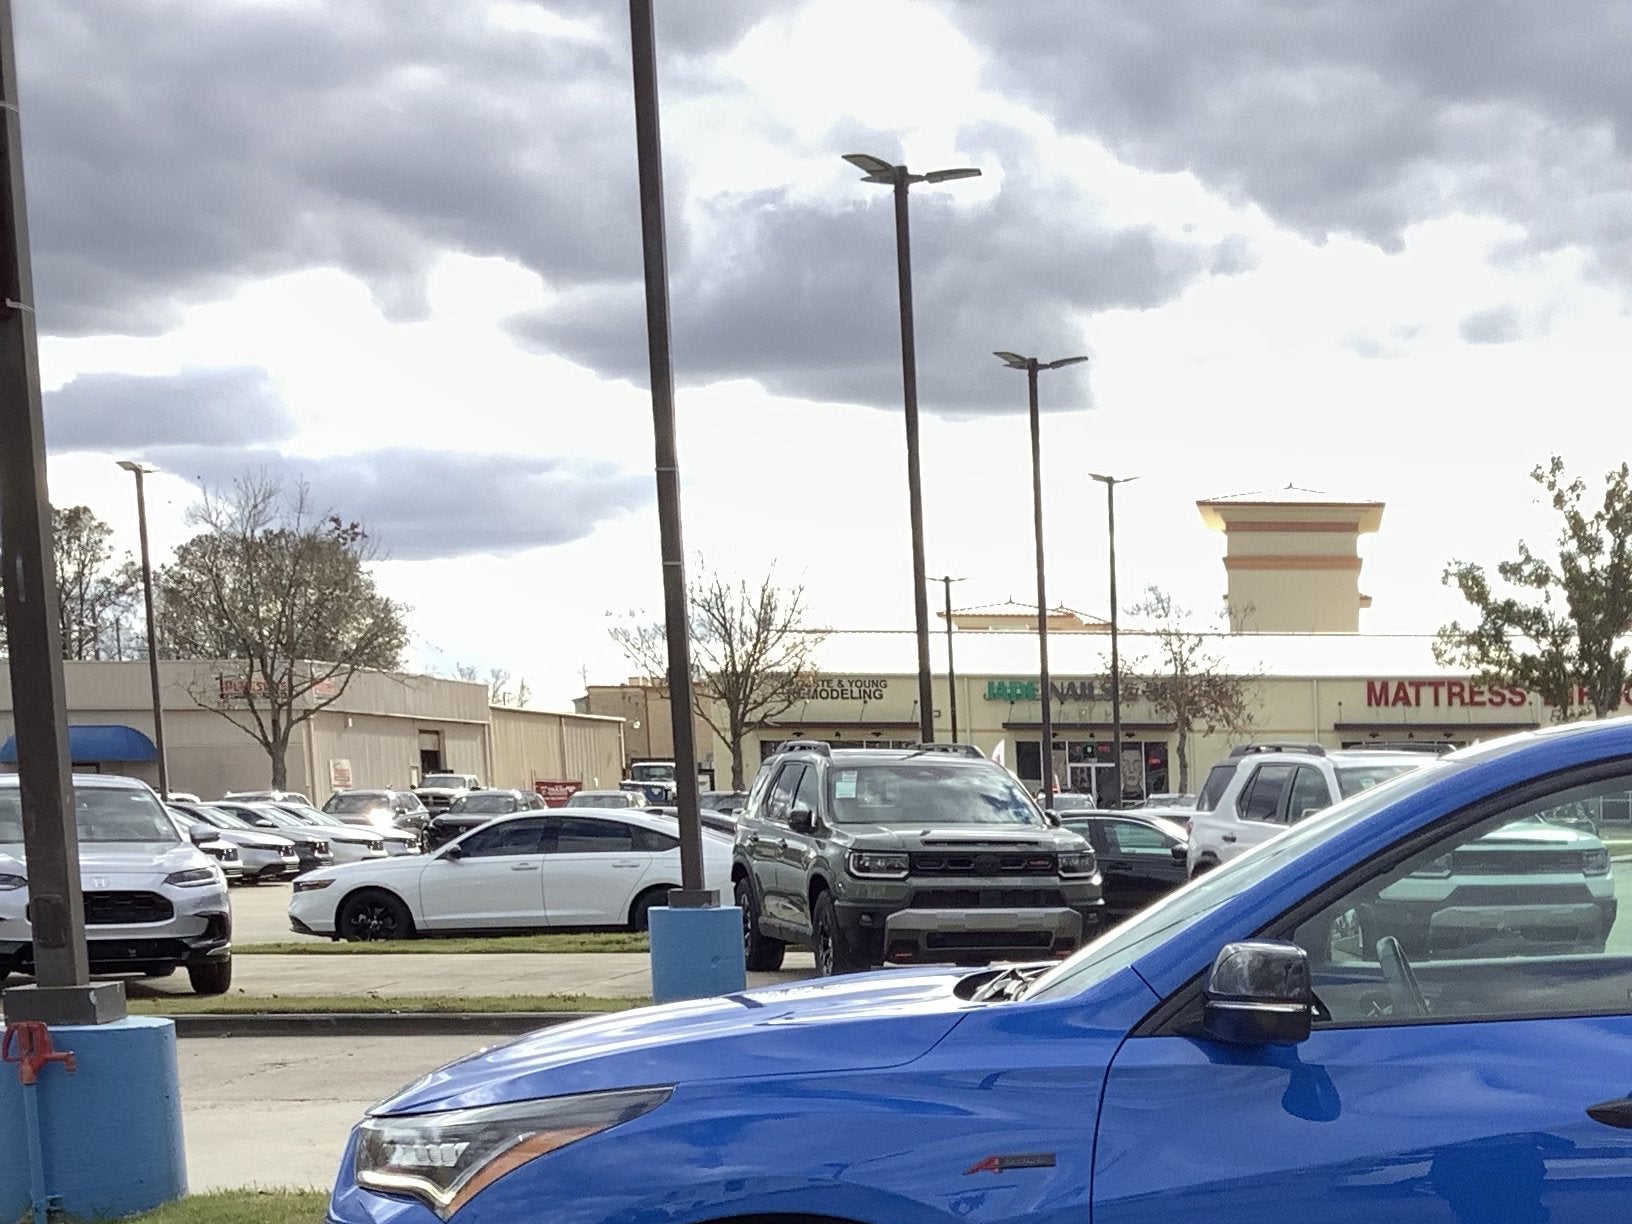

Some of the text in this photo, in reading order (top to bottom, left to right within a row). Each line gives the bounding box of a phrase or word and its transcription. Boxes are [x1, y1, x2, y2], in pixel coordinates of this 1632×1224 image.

[848, 679, 888, 688] YOUNG
[984, 681, 1039, 701] JADE
[1366, 680, 1527, 706] MATTRESS
